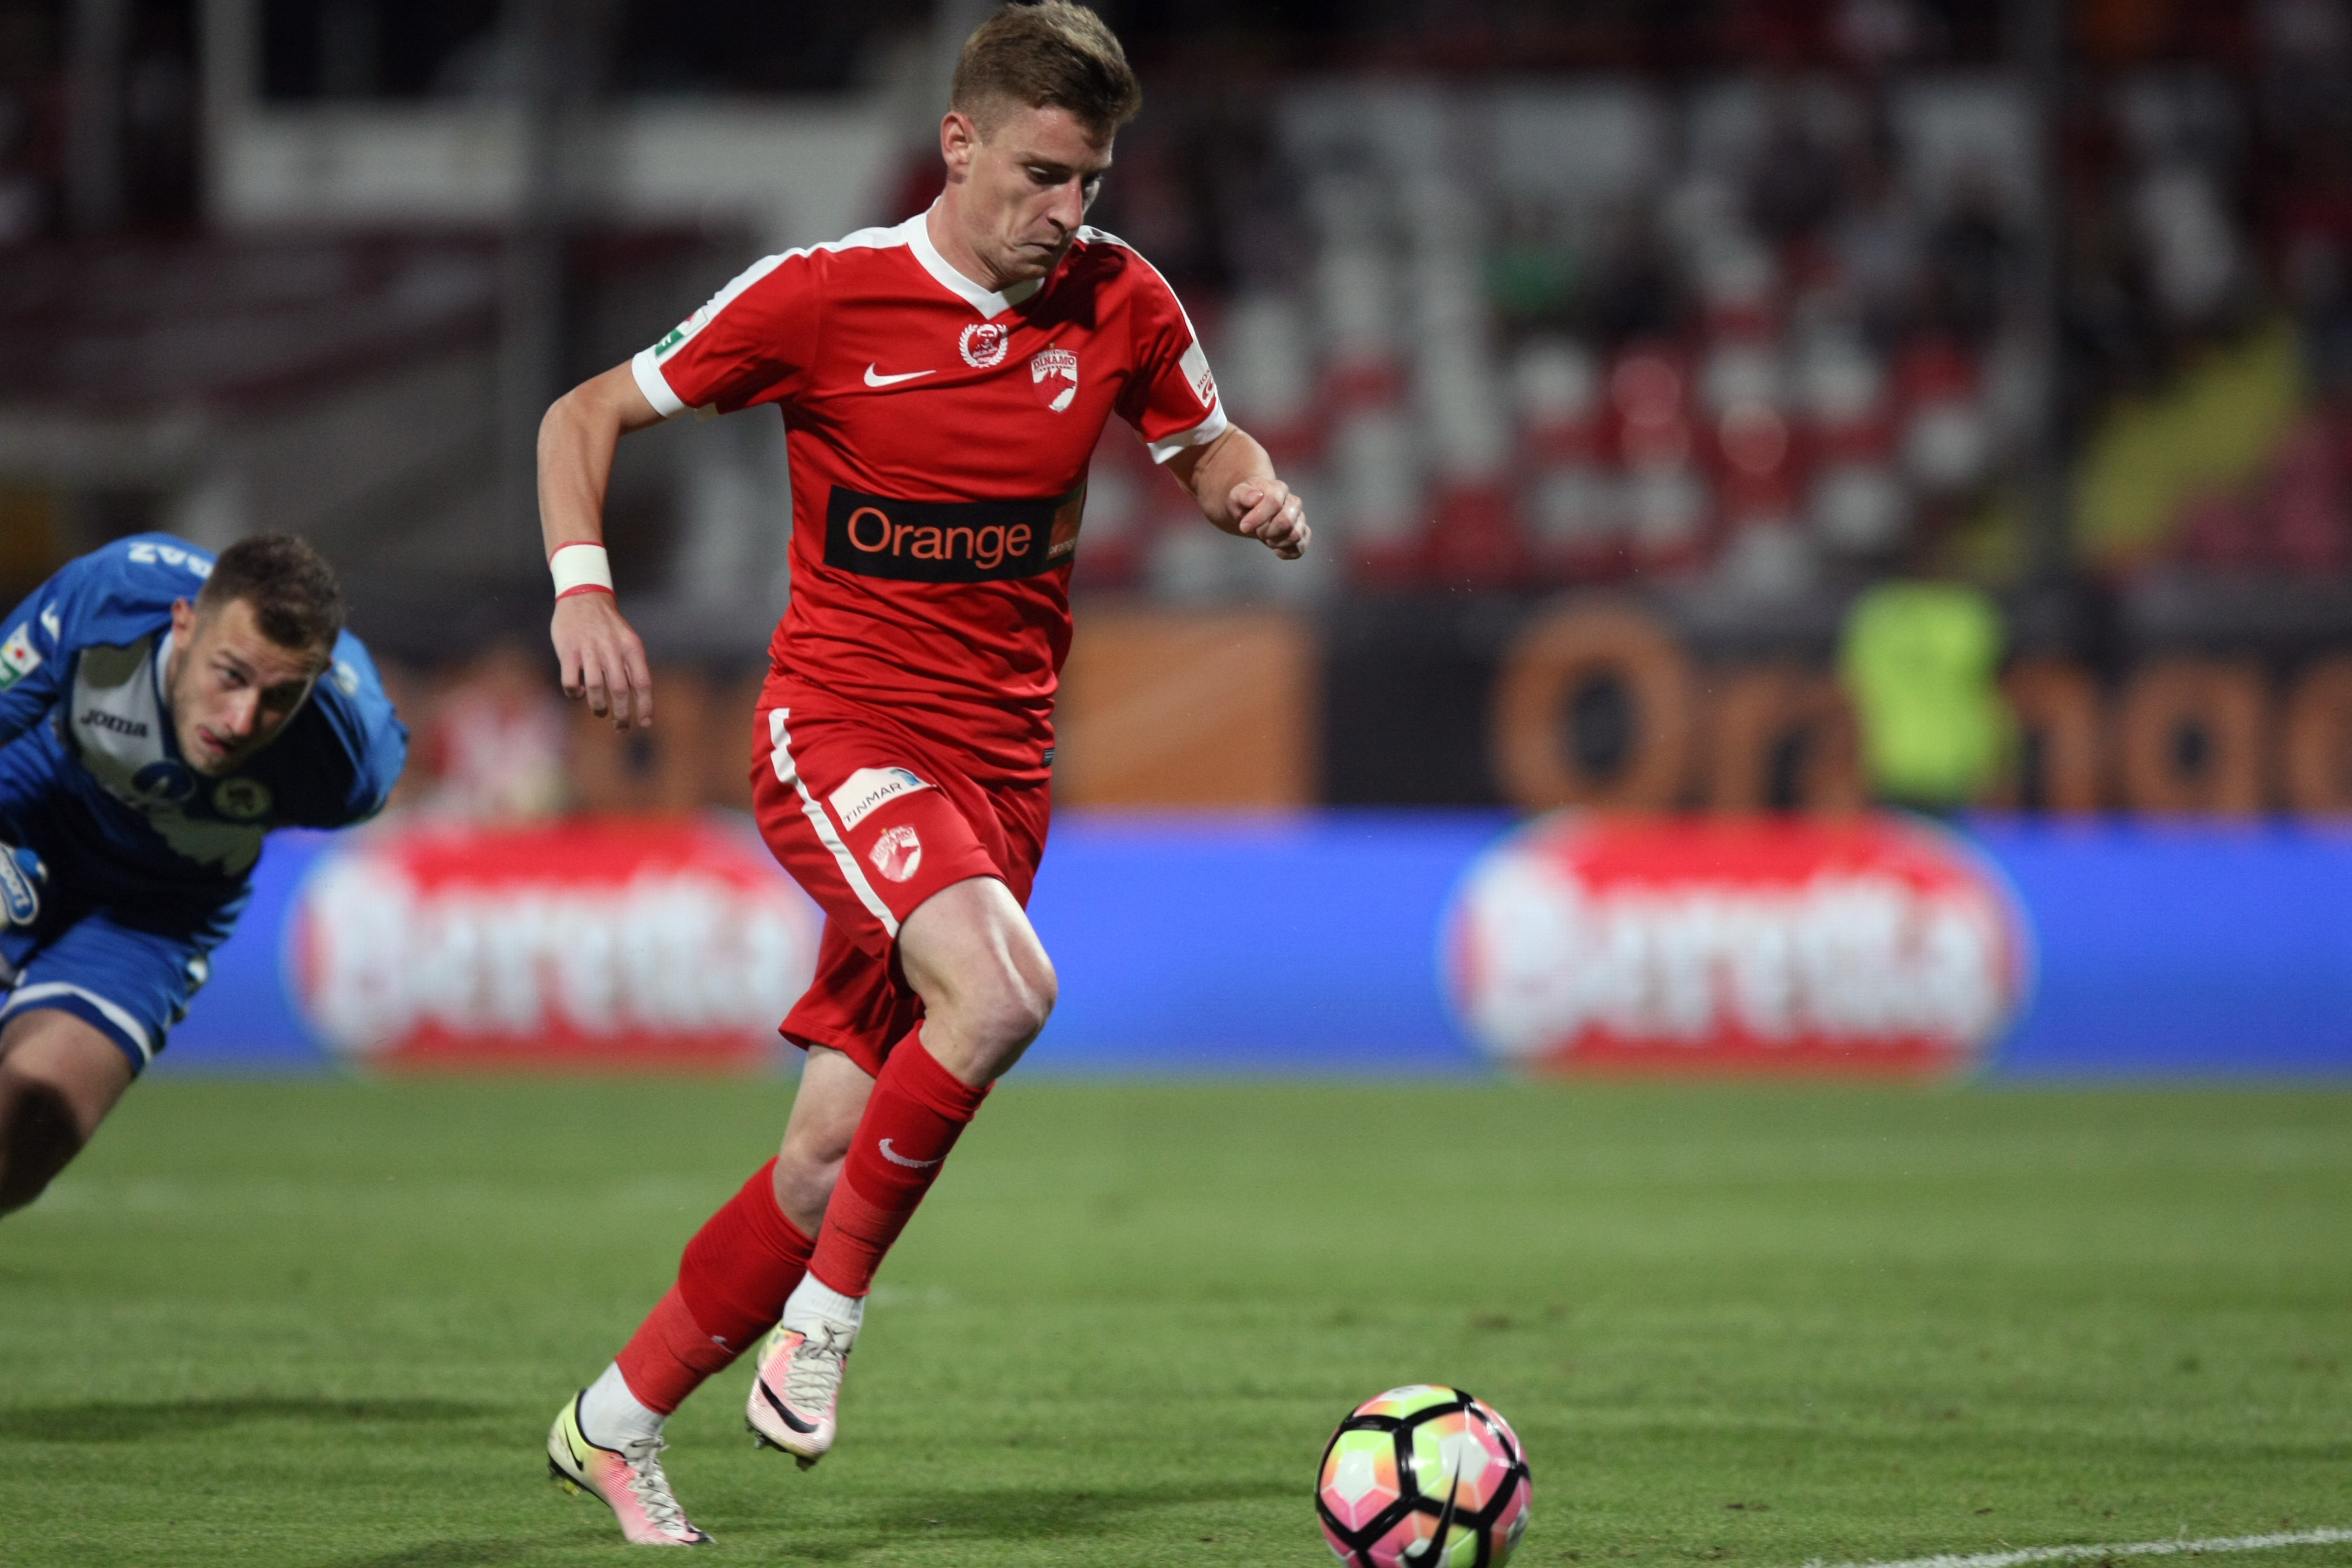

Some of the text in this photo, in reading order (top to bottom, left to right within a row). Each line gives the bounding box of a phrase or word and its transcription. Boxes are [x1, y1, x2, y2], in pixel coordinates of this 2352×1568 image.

[1034, 354, 1075, 368] DINAMO
[848, 507, 1031, 569] Orange
[843, 782, 903, 823] TINMAR
